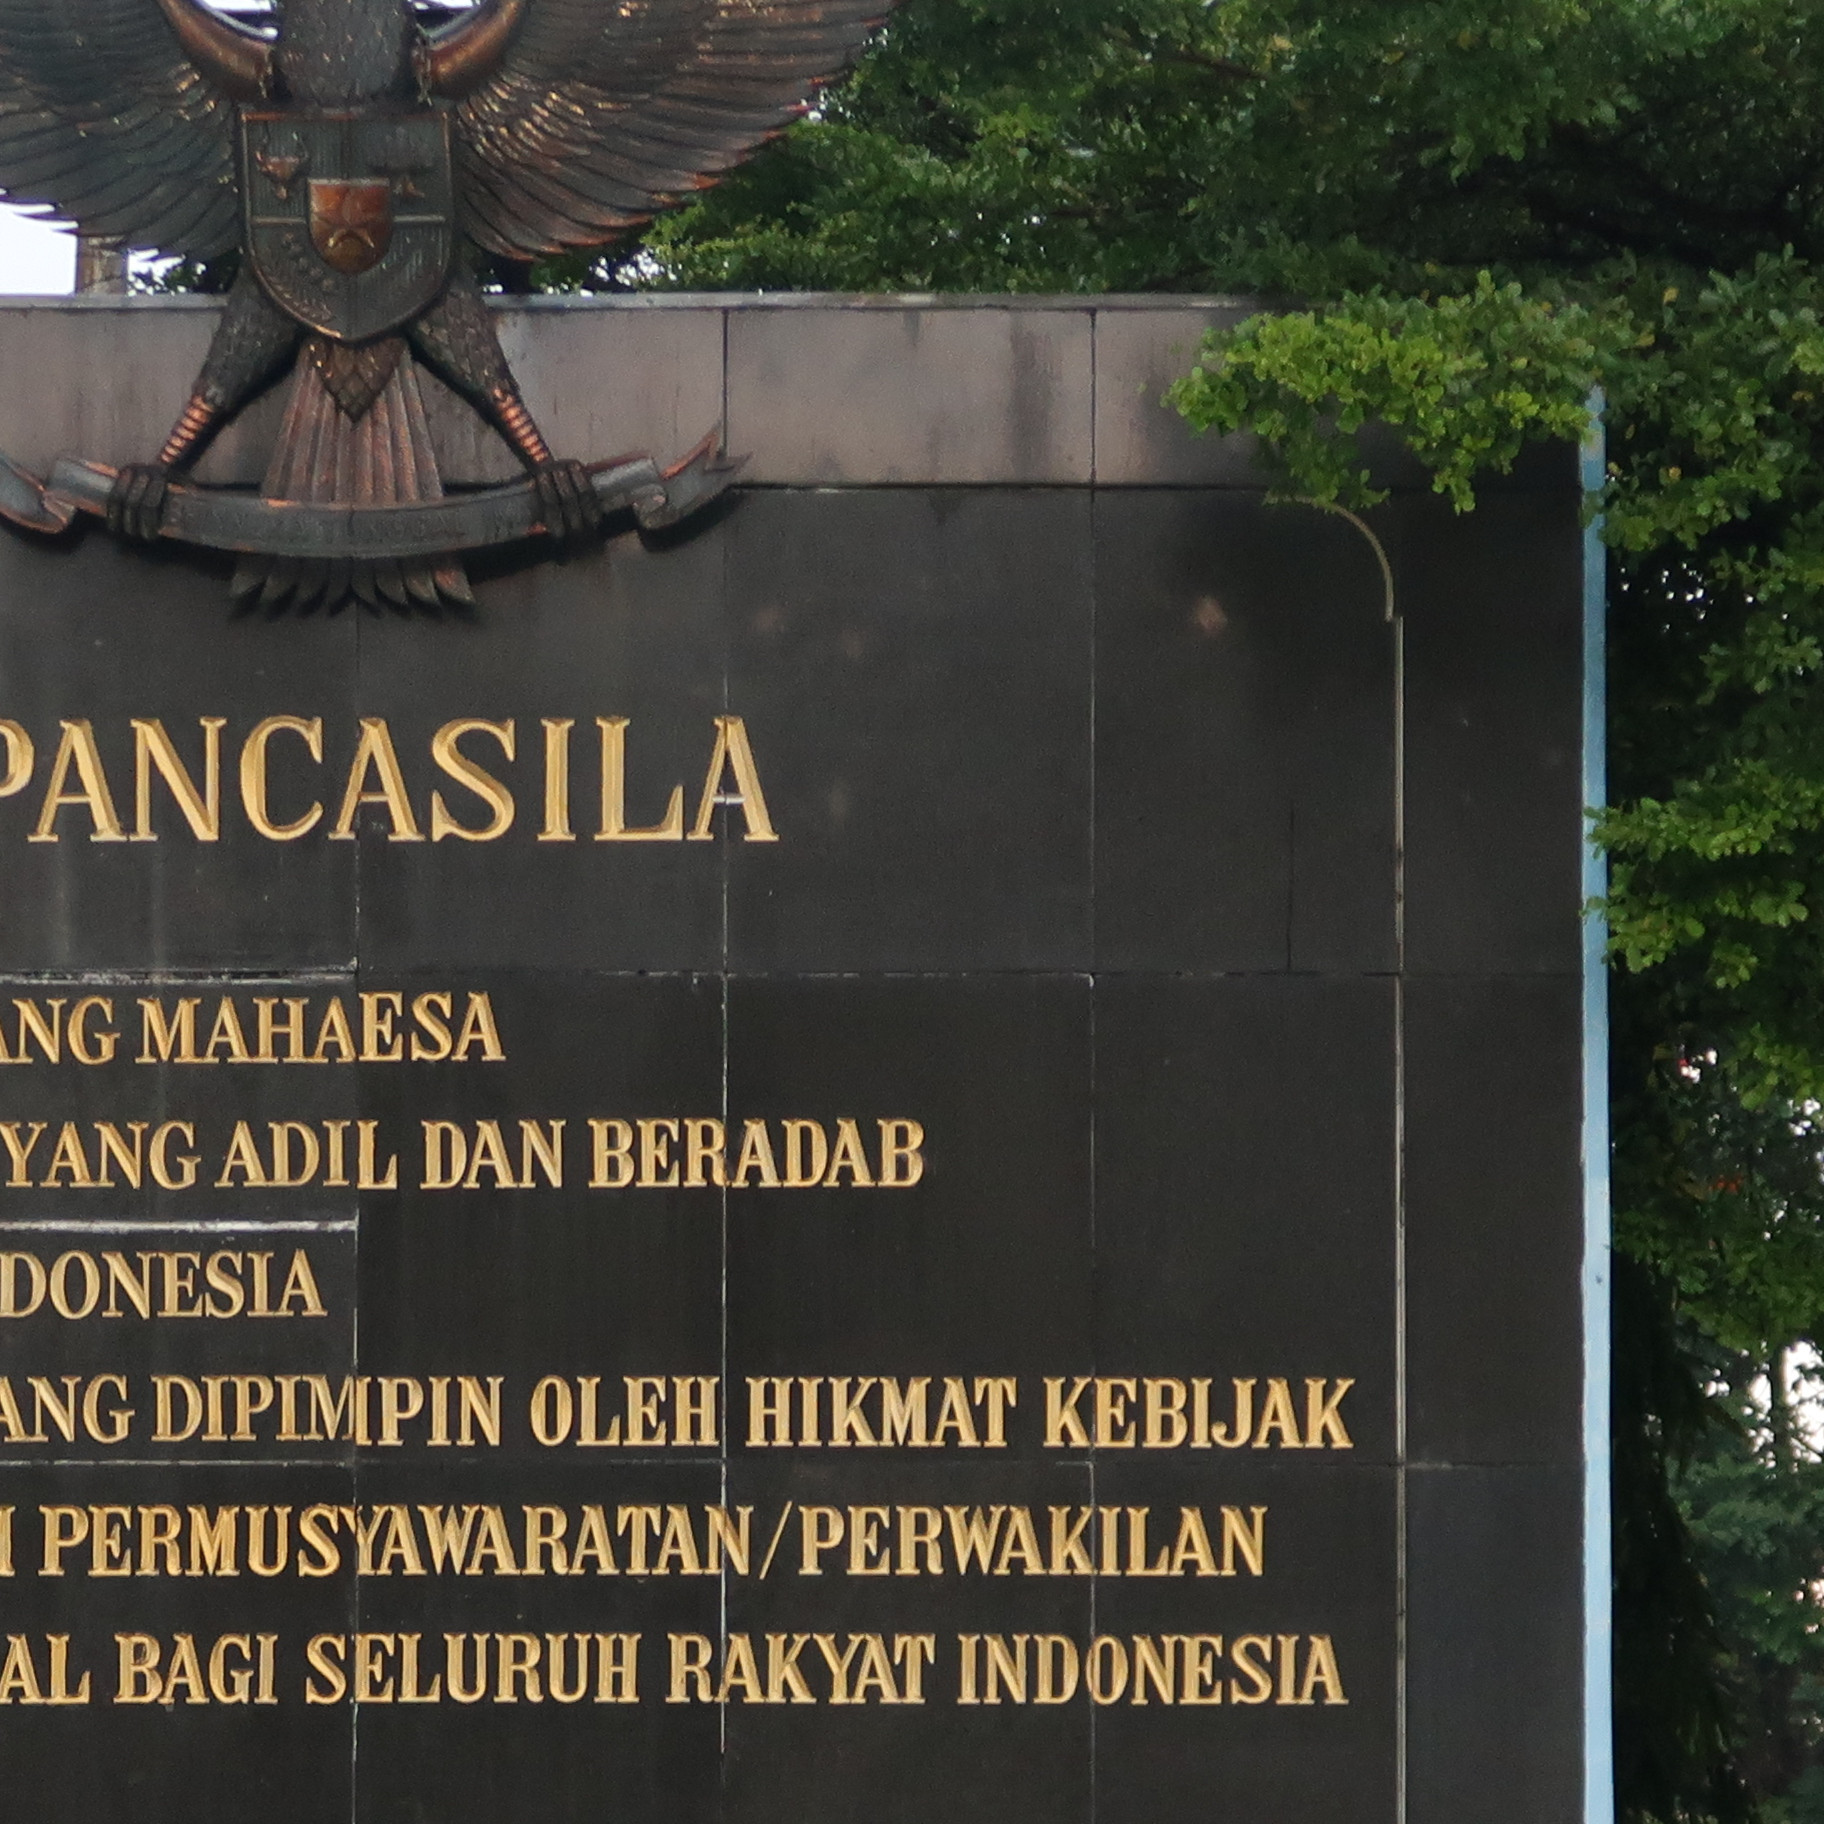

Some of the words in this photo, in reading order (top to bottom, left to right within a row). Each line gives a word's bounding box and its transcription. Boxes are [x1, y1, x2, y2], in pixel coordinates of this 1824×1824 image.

[134, 990, 506, 1065] MAHAESA
[214, 1118, 398, 1191] ADIL
[419, 1118, 566, 1191] DAN
[586, 1116, 925, 1190] BERADAB
[150, 1373, 503, 1448] DIPIMPIN
[529, 1374, 720, 1448] OLEH
[744, 1375, 1018, 1449] HIKMAT
[1042, 1375, 1356, 1451] KEBIJAK
[112, 1631, 279, 1706] BAGI
[304, 1631, 642, 1706] SELURUH
[664, 1631, 937, 1706] RAKYAT
[956, 1632, 1348, 1707] INDONESIA
